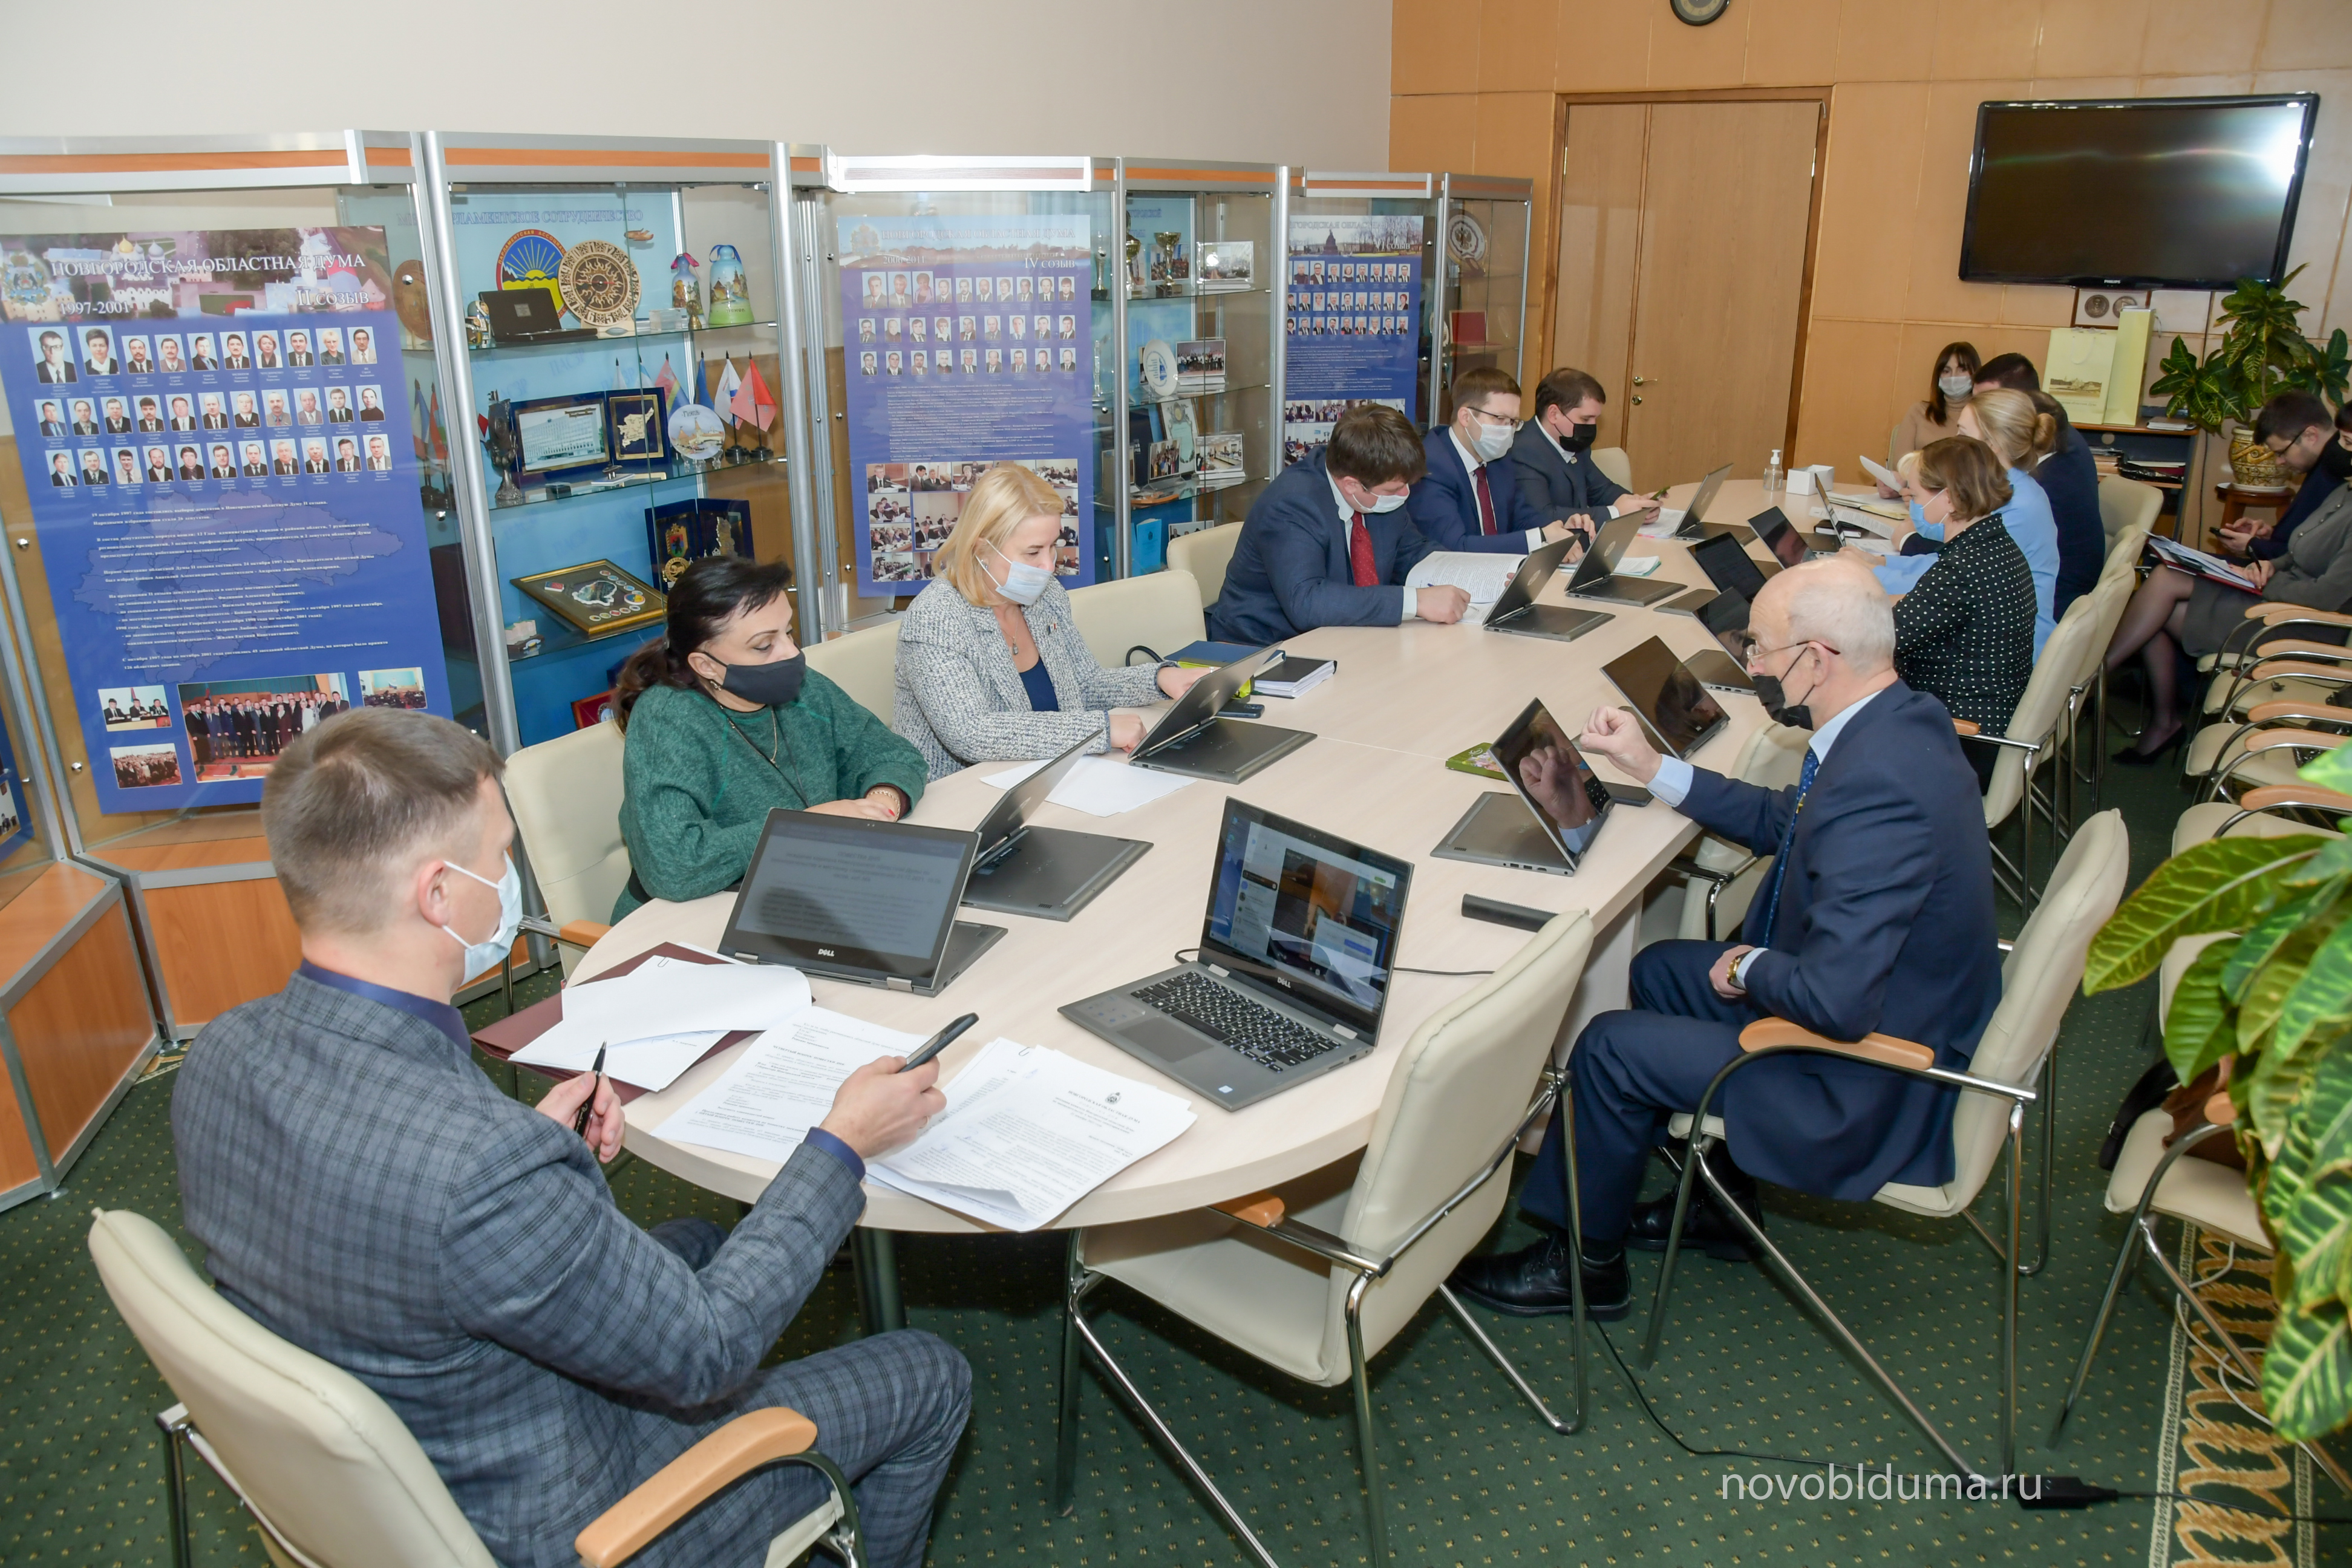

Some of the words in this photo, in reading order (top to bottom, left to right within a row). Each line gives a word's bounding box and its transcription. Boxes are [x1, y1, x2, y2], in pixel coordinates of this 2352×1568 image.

[542, 209, 643, 224] СОТРУДНИЧЕСТВО
[882, 230, 972, 240] НОВГОРОДСКАЯ
[973, 229, 1040, 239] ОБЛАСТНАЯ
[1042, 229, 1075, 240] ДУМА
[498, 230, 534, 264] ПАРЛАМЕНТСКАЯ
[538, 231, 567, 256] АССОЦИАЦ
[1375, 241, 1385, 250] VI
[51, 258, 198, 277] НОВГОРОДСКАЯ
[201, 255, 310, 272] ОБЛАСТНАЯ
[312, 253, 365, 270] ДУМА
[883, 255, 925, 264] 2006-2011
[1025, 258, 1039, 269] IV
[295, 289, 311, 305] II
[60, 300, 129, 315] 1997-2001
[817, 948, 835, 957] DELL
[1277, 977, 1291, 988] DELL
